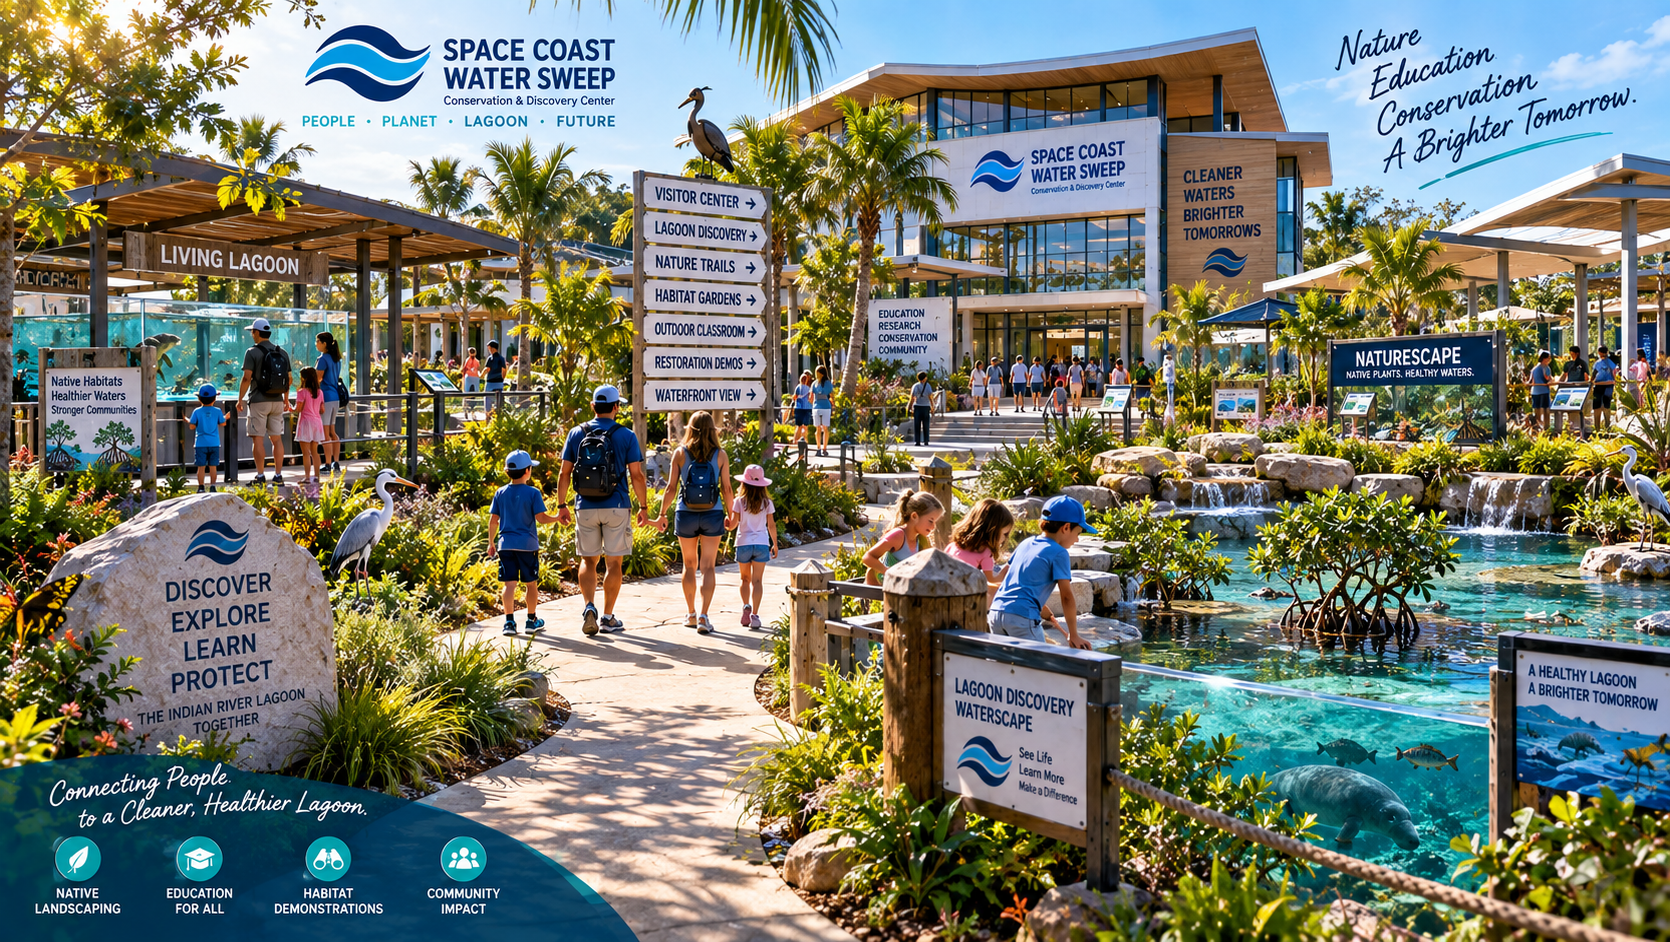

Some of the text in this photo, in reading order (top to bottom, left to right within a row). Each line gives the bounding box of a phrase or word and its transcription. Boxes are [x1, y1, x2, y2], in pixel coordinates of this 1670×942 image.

[1031, 140, 1126, 165] SPACE COAST
[1031, 160, 1126, 183] WATER SWEEP
[1183, 165, 1243, 184] CLEANER
[655, 186, 739, 209] VISITOR CENTER
[1031, 185, 1069, 195] Conservation
[1105, 180, 1126, 189] Center
[1183, 185, 1235, 203] WATERS
[1183, 205, 1244, 222] BRIGHTER
[655, 220, 747, 242] LAGOON DISCOVERY
[1183, 223, 1261, 241] TOMORROWS
[161, 244, 299, 276] LIVING LAGOON
[655, 254, 735, 274] NATURE TRAILS
[655, 288, 742, 306] HABITAT GARDENS
[878, 308, 925, 318] EDUCATION
[654, 322, 745, 338] OUTDOOR CLASSROOM
[878, 321, 921, 331] RESEARCH
[878, 333, 938, 343] CONSERVATION
[878, 345, 928, 355] COMMUNITY
[1355, 346, 1462, 368] NATURESCAPE
[655, 355, 744, 370] RESTORATION DEMOS
[51, 375, 123, 387] Native Habitats
[1346, 367, 1475, 379] NATIVE PLANTS. HEALTHY WATERS.
[51, 390, 127, 401] Healthier Waters
[655, 388, 742, 402] WATERFRONT VIEW
[51, 404, 137, 417] Stronger Communities
[165, 572, 272, 603] DISCOVER
[171, 601, 271, 634] EXPLORE
[183, 632, 257, 662] LEARN
[171, 659, 273, 694] PROTECT
[1528, 663, 1637, 689] A HEALTHY LAGOON
[137, 687, 306, 726] THE INDIAN RIVER LAGOON
[955, 677, 1075, 718] LAGOON DISCOVERY
[1528, 681, 1659, 712] A BRIGHTER TOMORROW
[193, 712, 260, 735] TOGETHER
[955, 700, 1033, 733] WATERSCAPE
[1019, 746, 1053, 766] See Life
[1019, 763, 1065, 786] Learn More
[1019, 780, 1078, 806] Make a Difference
